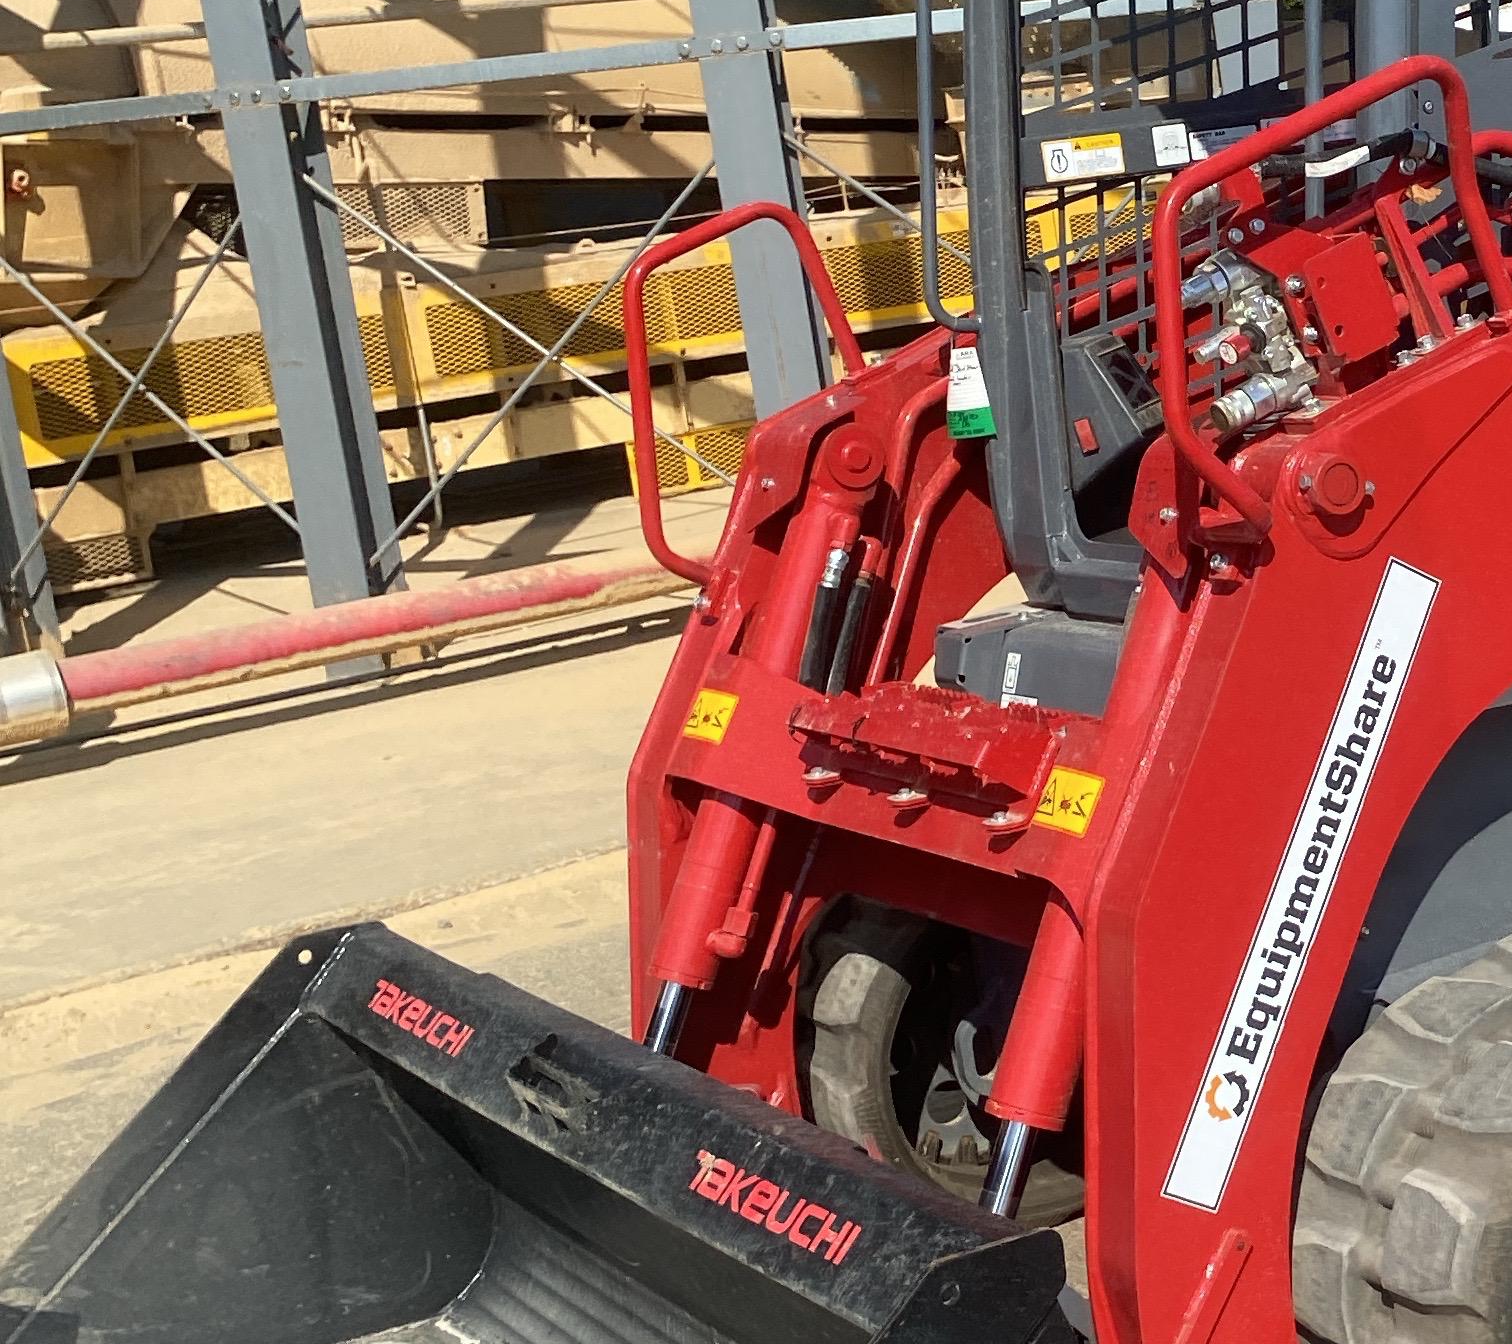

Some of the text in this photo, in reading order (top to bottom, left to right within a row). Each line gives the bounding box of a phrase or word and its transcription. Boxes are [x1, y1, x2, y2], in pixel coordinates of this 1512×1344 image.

[1226, 654, 1397, 1065] EquipmentShare
[367, 978, 476, 1058] TAKEUCHI
[688, 1148, 863, 1266] TAKEUCHI
